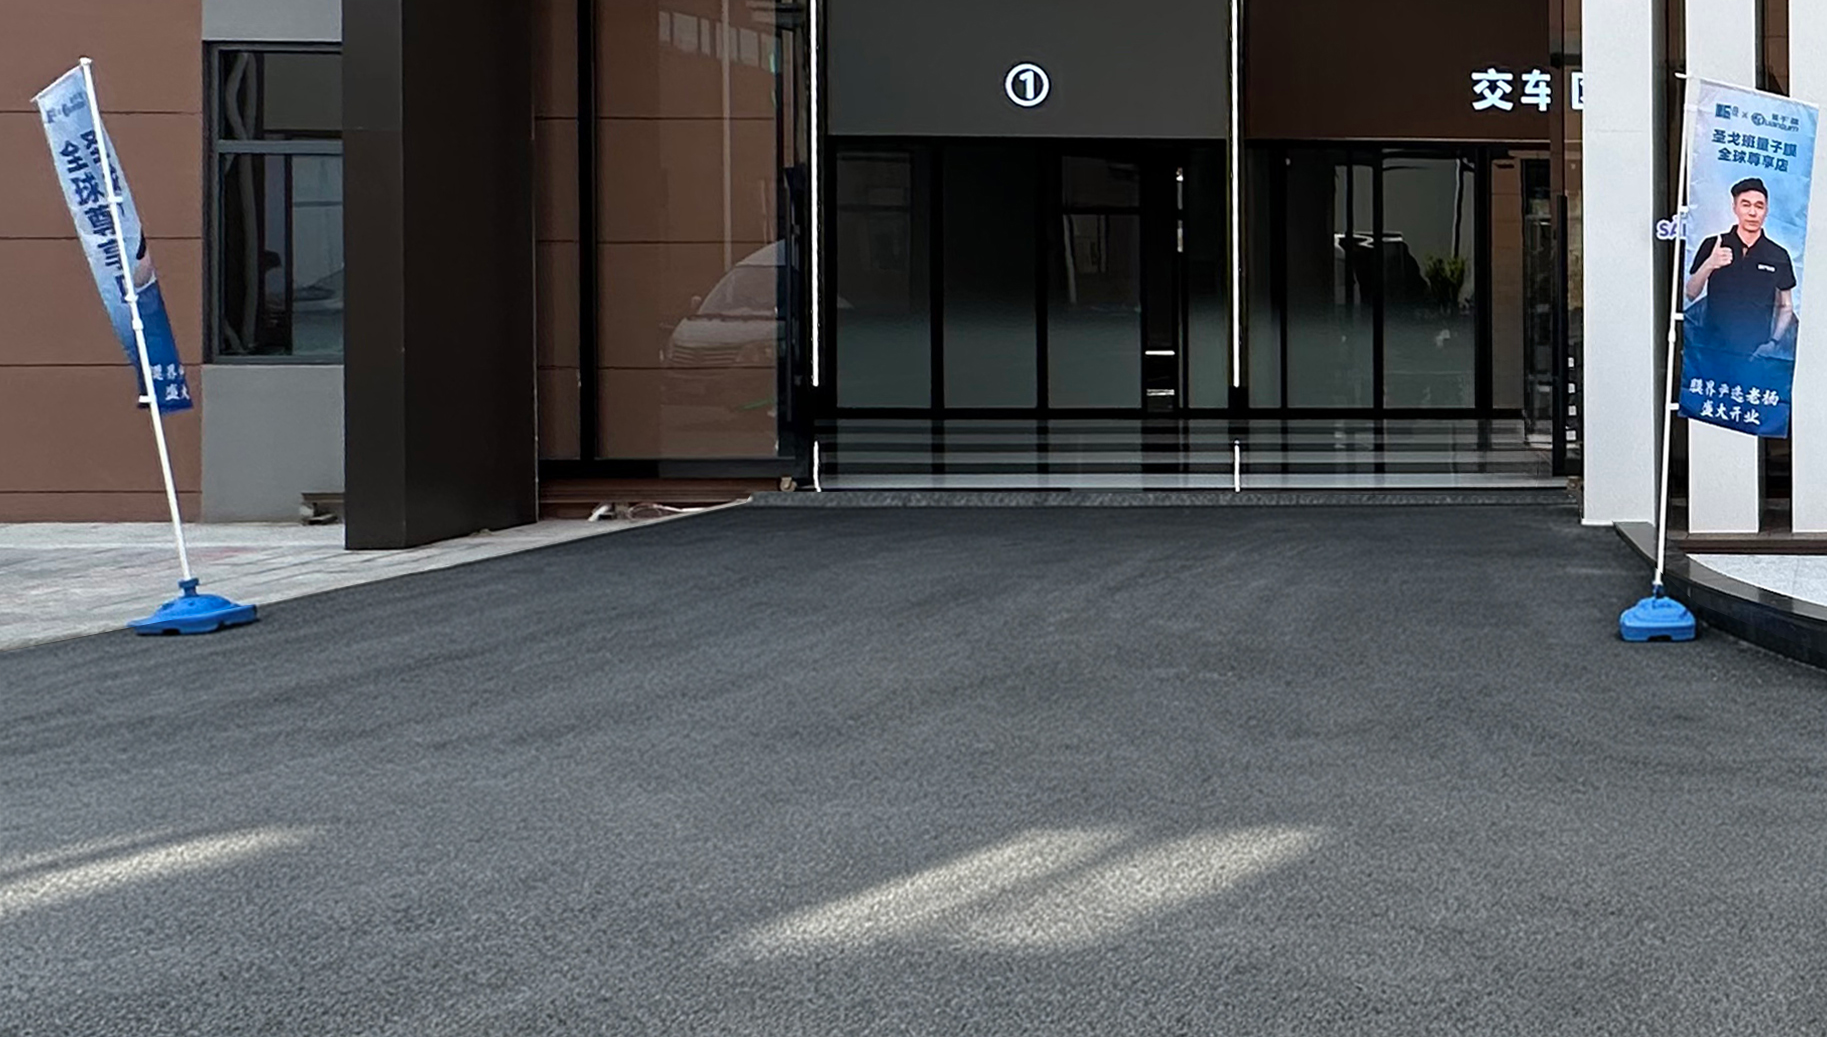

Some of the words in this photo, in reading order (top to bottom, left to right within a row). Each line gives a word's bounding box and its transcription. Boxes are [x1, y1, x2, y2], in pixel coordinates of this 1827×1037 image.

[1711, 128, 1798, 157] 圣戈班量子膜
[1717, 147, 1789, 172] 全球尊享店
[1688, 377, 1780, 407] 膜界严选老杨
[1700, 399, 1761, 425] 盛大开业
